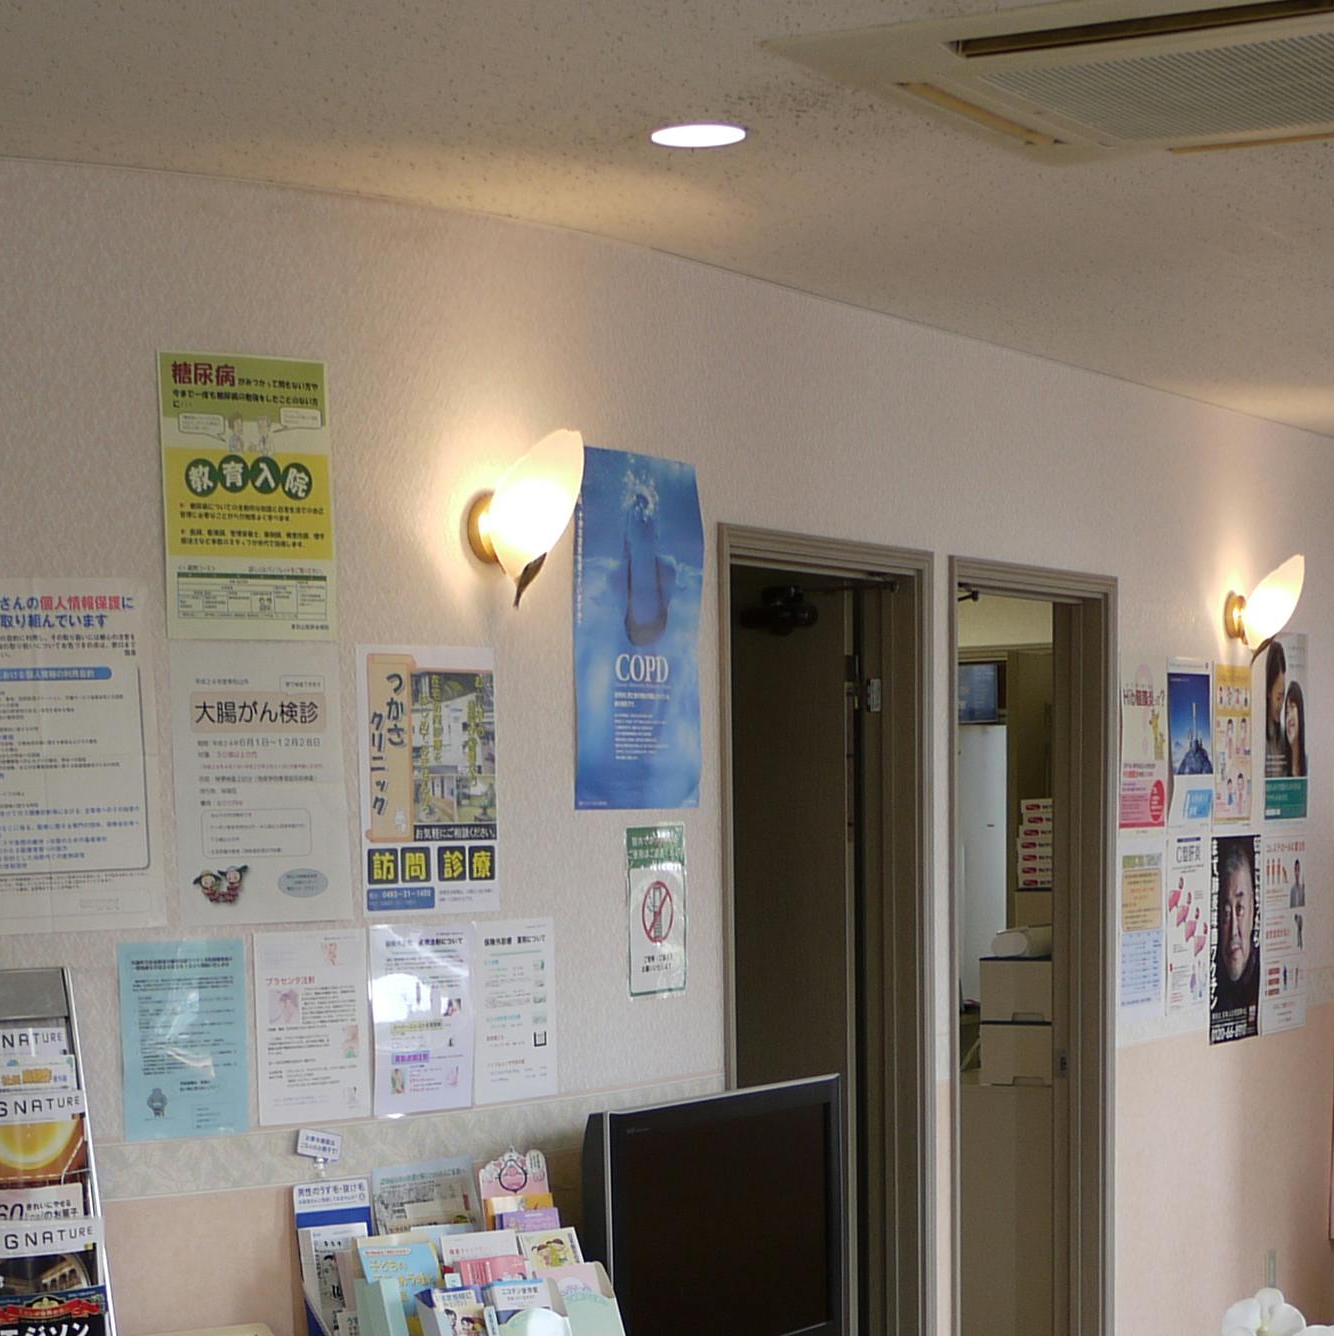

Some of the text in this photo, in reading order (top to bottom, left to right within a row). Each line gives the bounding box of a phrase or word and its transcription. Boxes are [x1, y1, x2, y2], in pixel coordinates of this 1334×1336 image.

[171, 360, 236, 387] 糖尿病
[188, 459, 310, 499] 教育入院
[615, 653, 669, 683] COPD
[194, 700, 319, 724] 大腸がん検診
[386, 672, 405, 748] つかさ
[370, 711, 389, 816] クリニック
[372, 852, 492, 881] 訪問診療
